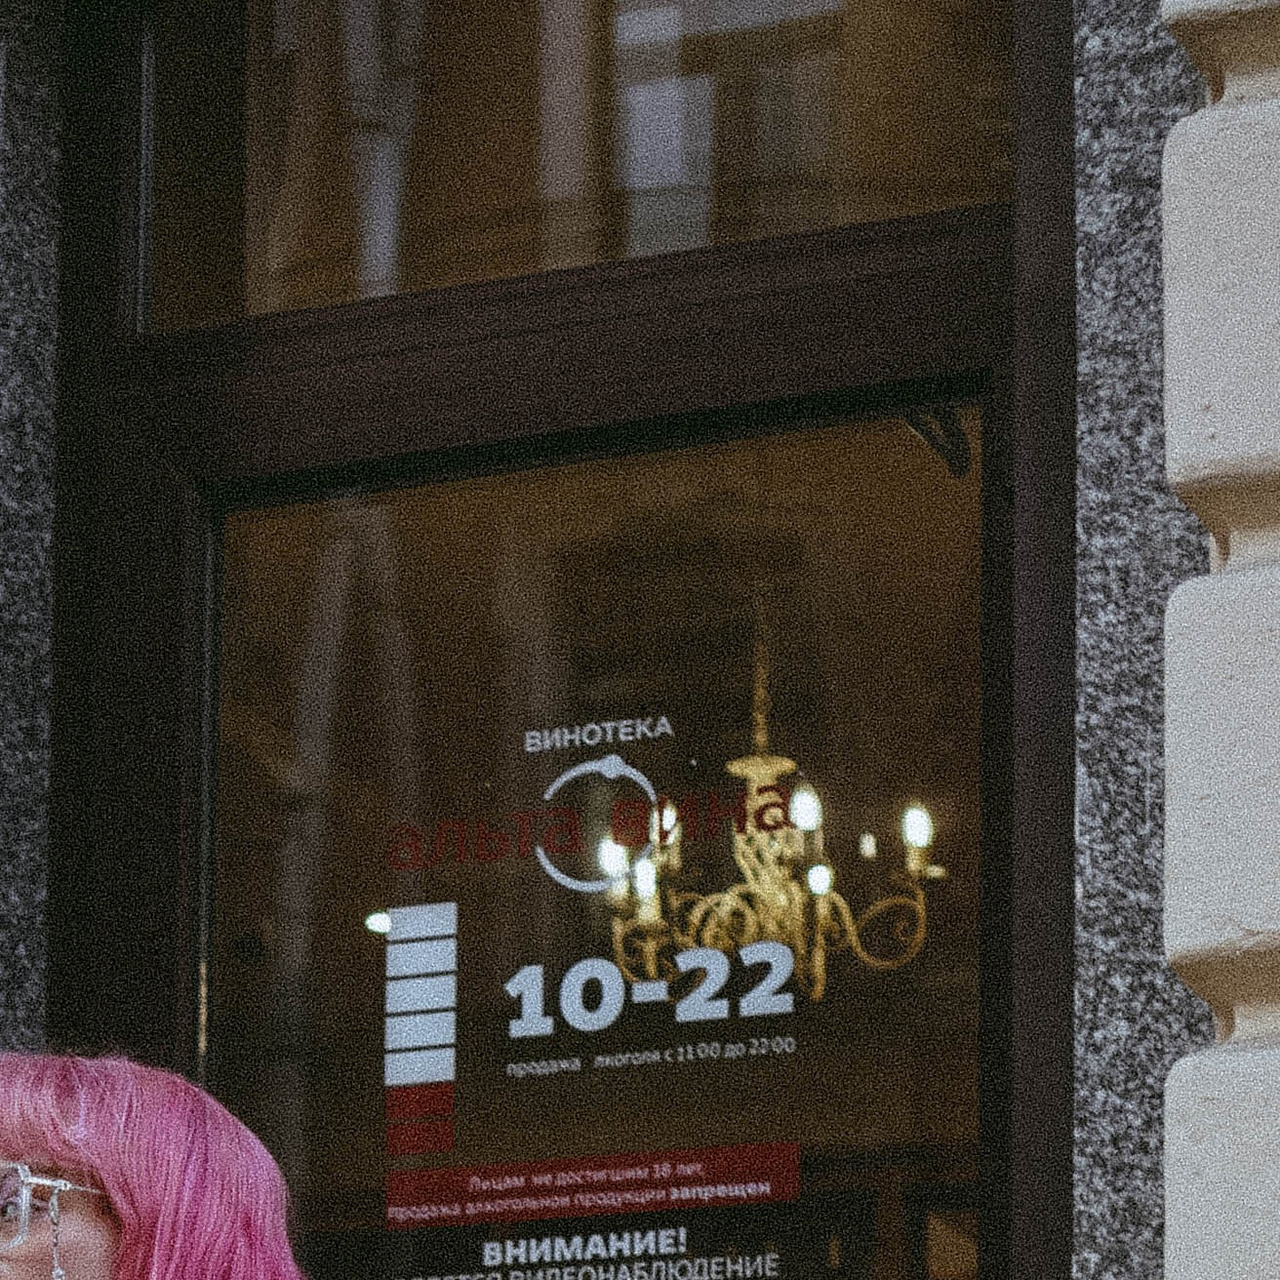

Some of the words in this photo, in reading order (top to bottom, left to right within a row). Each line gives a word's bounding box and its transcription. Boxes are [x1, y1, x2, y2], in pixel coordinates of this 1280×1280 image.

[524, 715, 675, 753] ВИНОТЕКА
[503, 941, 795, 1038] 10-22
[593, 1050, 661, 1069] лкоголя
[482, 1228, 688, 1267] ВНИМАНИЕ!
